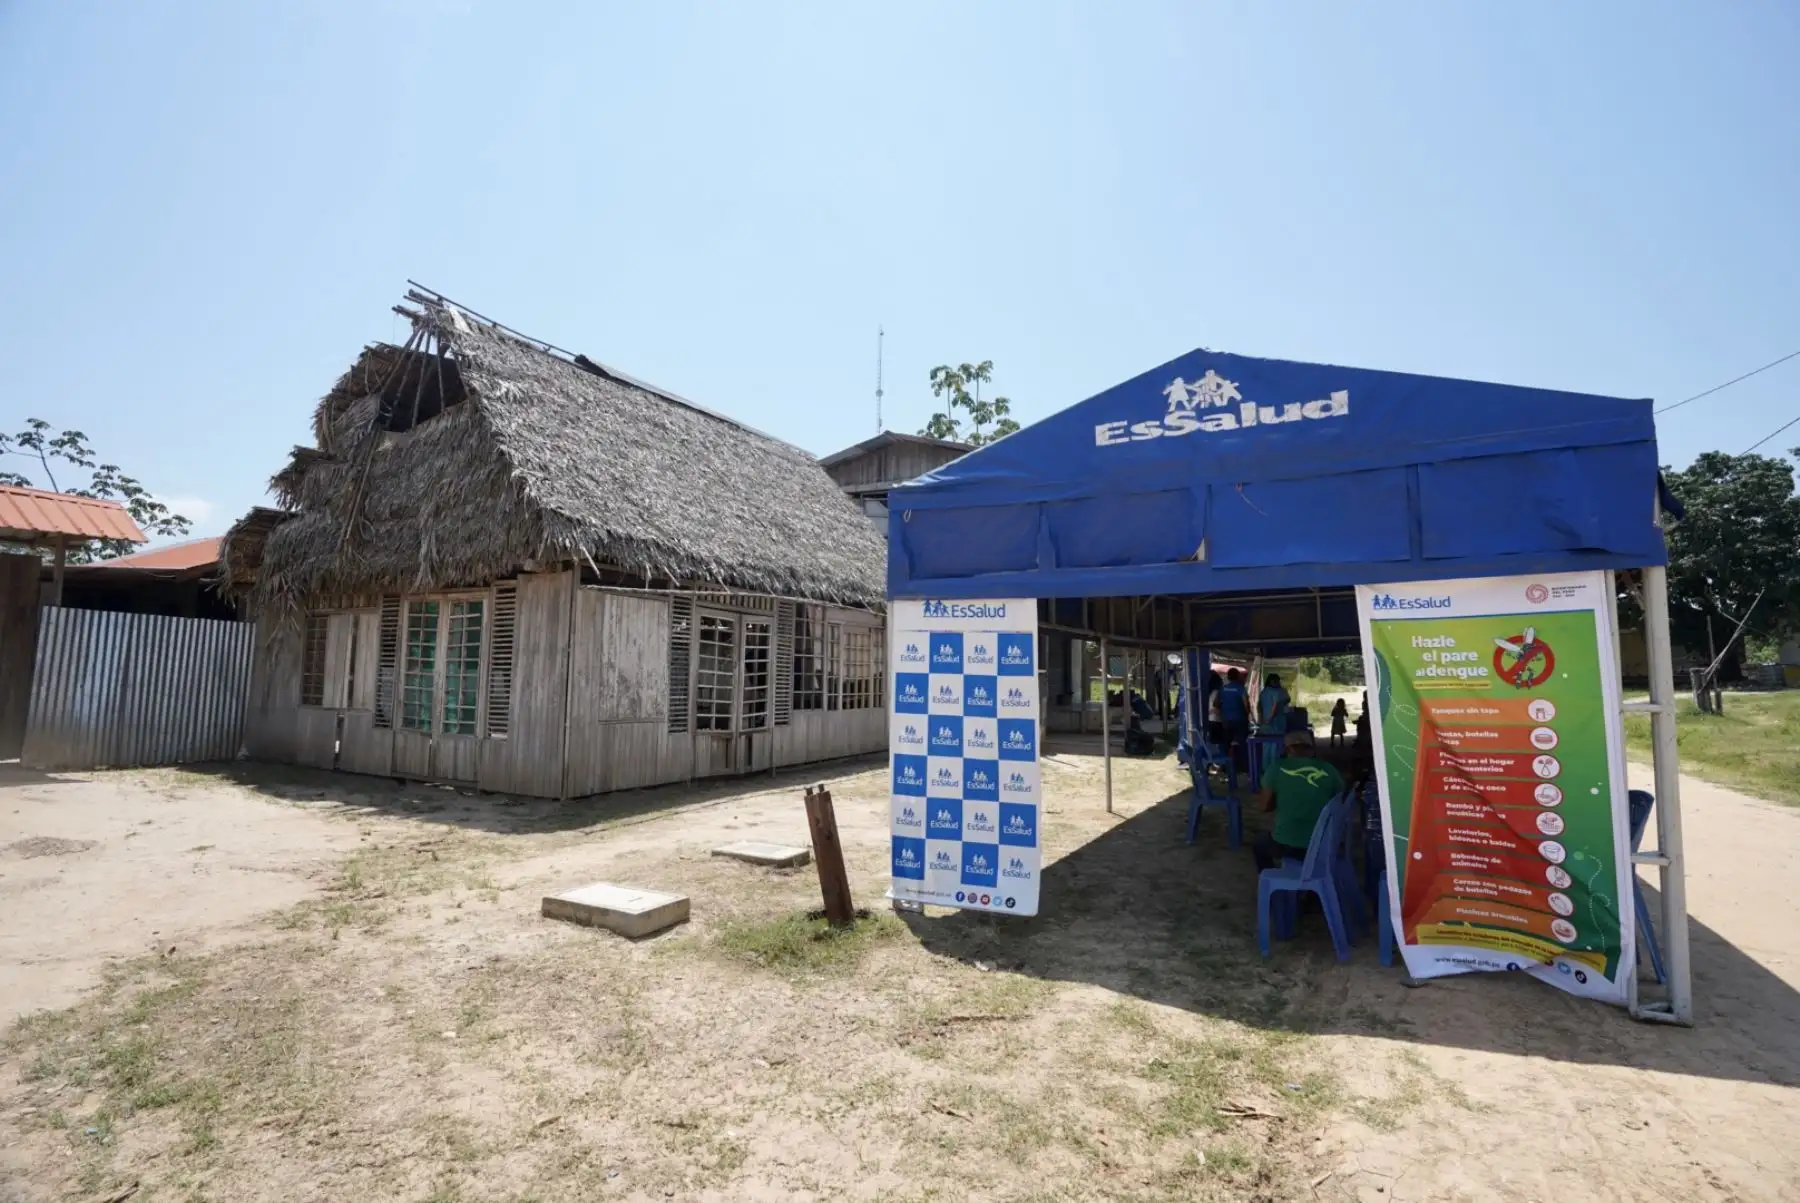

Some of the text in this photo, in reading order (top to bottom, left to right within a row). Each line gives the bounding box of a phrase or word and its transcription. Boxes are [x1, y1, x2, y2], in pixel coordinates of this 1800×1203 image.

[1095, 389, 1349, 447] EsSalud
[1399, 596, 1451, 609] EsSalud
[951, 604, 1006, 618] EsSalud
[1411, 634, 1456, 648] Hazle
[933, 655, 960, 663] EsSalud
[967, 655, 994, 664] EsSalud
[1001, 656, 1029, 665] EsSalud
[1422, 649, 1478, 665] el pare
[1426, 664, 1488, 679] dengue
[899, 695, 925, 704] EsSalud
[932, 695, 960, 704] EsSalud
[967, 697, 993, 706] EsSalud
[1001, 699, 1030, 707] EsSalud
[898, 736, 924, 744] EsSalud
[932, 737, 959, 746] EsSalud
[967, 739, 993, 748] EsSalud
[1002, 741, 1032, 750] EsSalud
[897, 776, 923, 786] EsSalud
[931, 779, 959, 788] EsSalud
[967, 781, 995, 790] EsSalud
[1003, 783, 1032, 792] EsSalud
[896, 817, 922, 827] EsSalud
[930, 820, 959, 829] EsSalud
[967, 823, 995, 832] EsSalud
[1003, 825, 1032, 835] EsSalud
[895, 859, 921, 868] EsSalud
[929, 862, 958, 872] EsSalud
[965, 865, 994, 875] EsSalud
[1002, 869, 1031, 879] EsSalud
